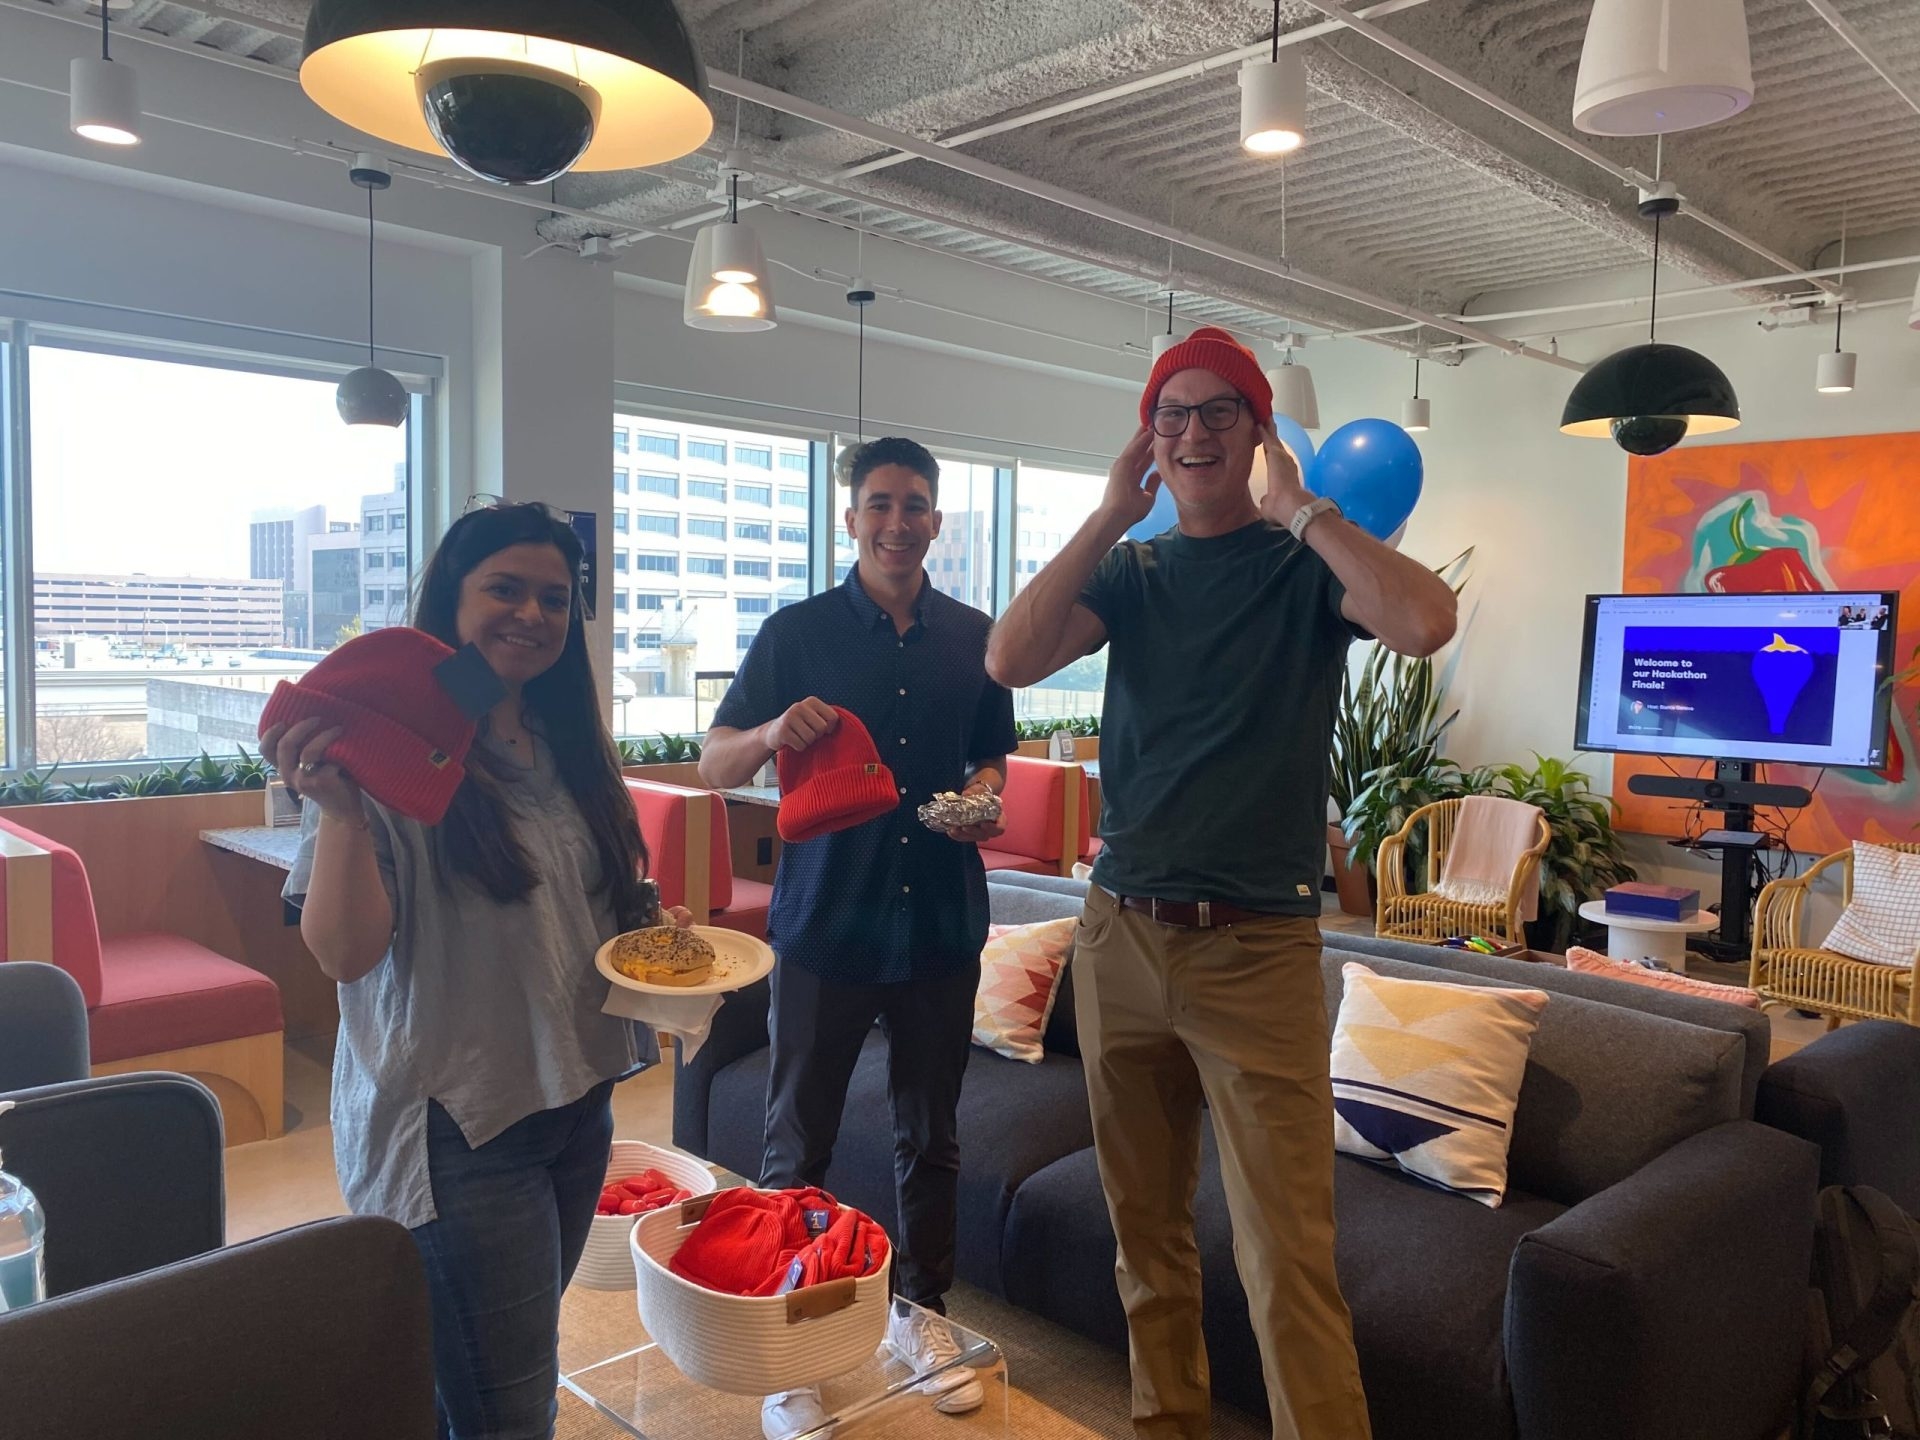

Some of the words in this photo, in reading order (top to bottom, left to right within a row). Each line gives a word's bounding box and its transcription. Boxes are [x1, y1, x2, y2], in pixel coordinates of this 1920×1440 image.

[1634, 658, 1679, 667] Welcome
[1681, 660, 1693, 668] to
[1652, 670, 1707, 679] Hackathon
[1632, 680, 1665, 690] Finale!
